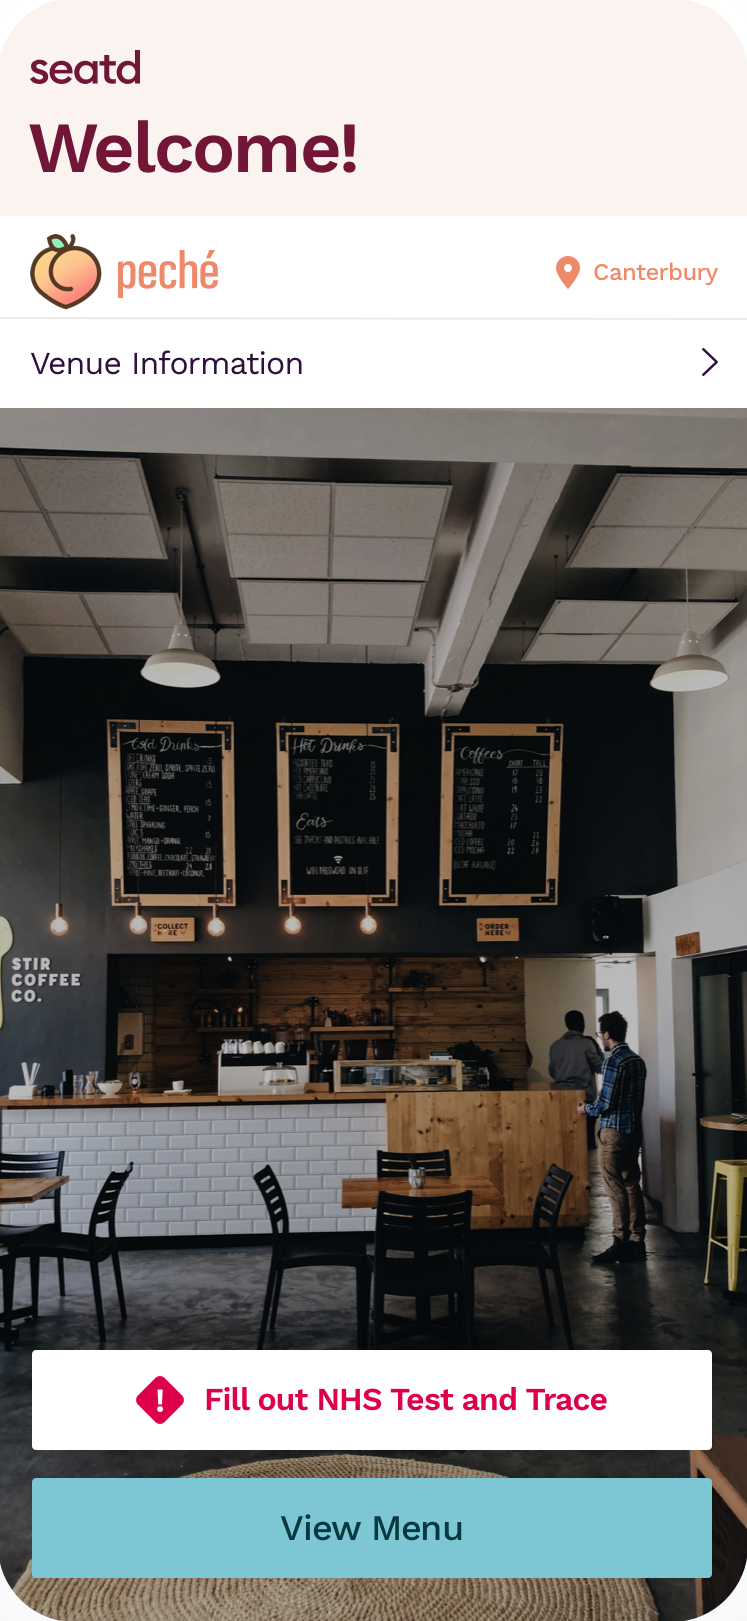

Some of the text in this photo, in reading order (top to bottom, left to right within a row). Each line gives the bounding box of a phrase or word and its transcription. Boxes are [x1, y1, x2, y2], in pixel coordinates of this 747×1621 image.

[131, 735, 200, 752] Cold Drinks
[292, 737, 364, 755] Hot Drinks
[460, 746, 504, 764] Coffees
[295, 812, 333, 831] Eats
[11, 957, 51, 971] STIR
[11, 973, 81, 987] COFFEE
[11, 989, 43, 1003] CO.
